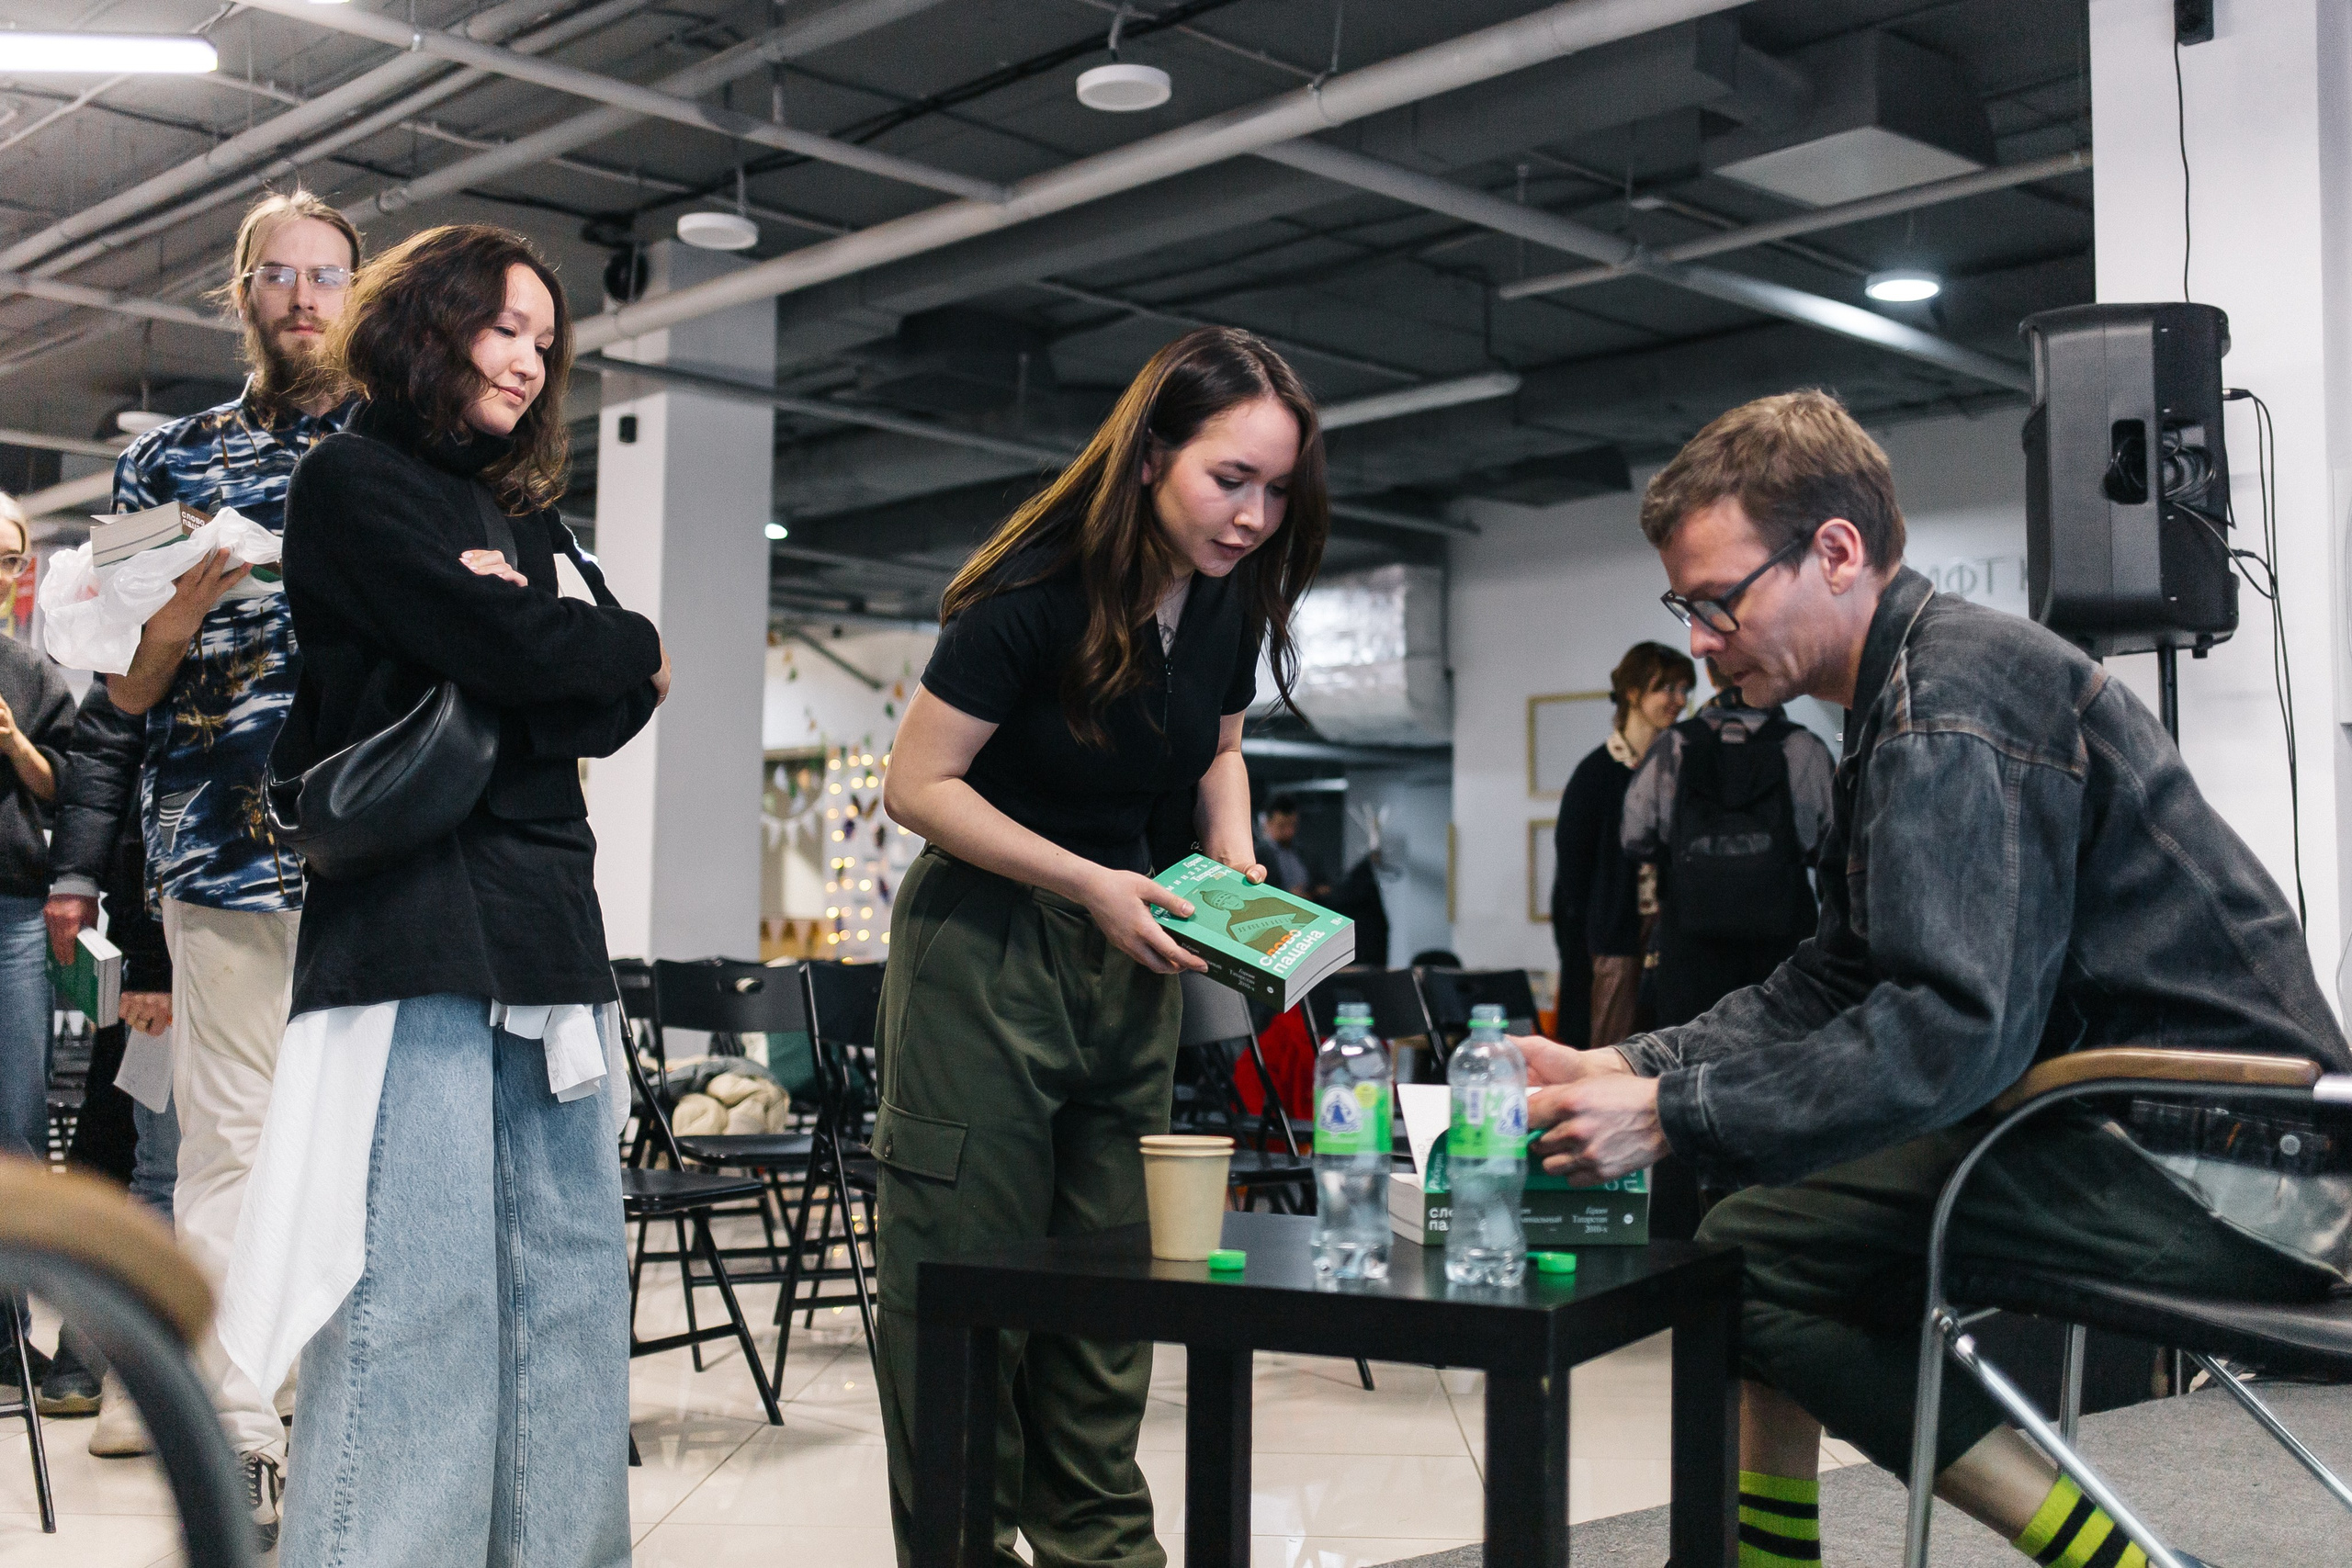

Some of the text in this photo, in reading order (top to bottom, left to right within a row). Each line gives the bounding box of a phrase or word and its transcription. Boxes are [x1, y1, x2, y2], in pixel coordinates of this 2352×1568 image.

[181, 511, 205, 526] слово
[1259, 929, 1302, 967] слово
[1272, 930, 1326, 974] пацана
